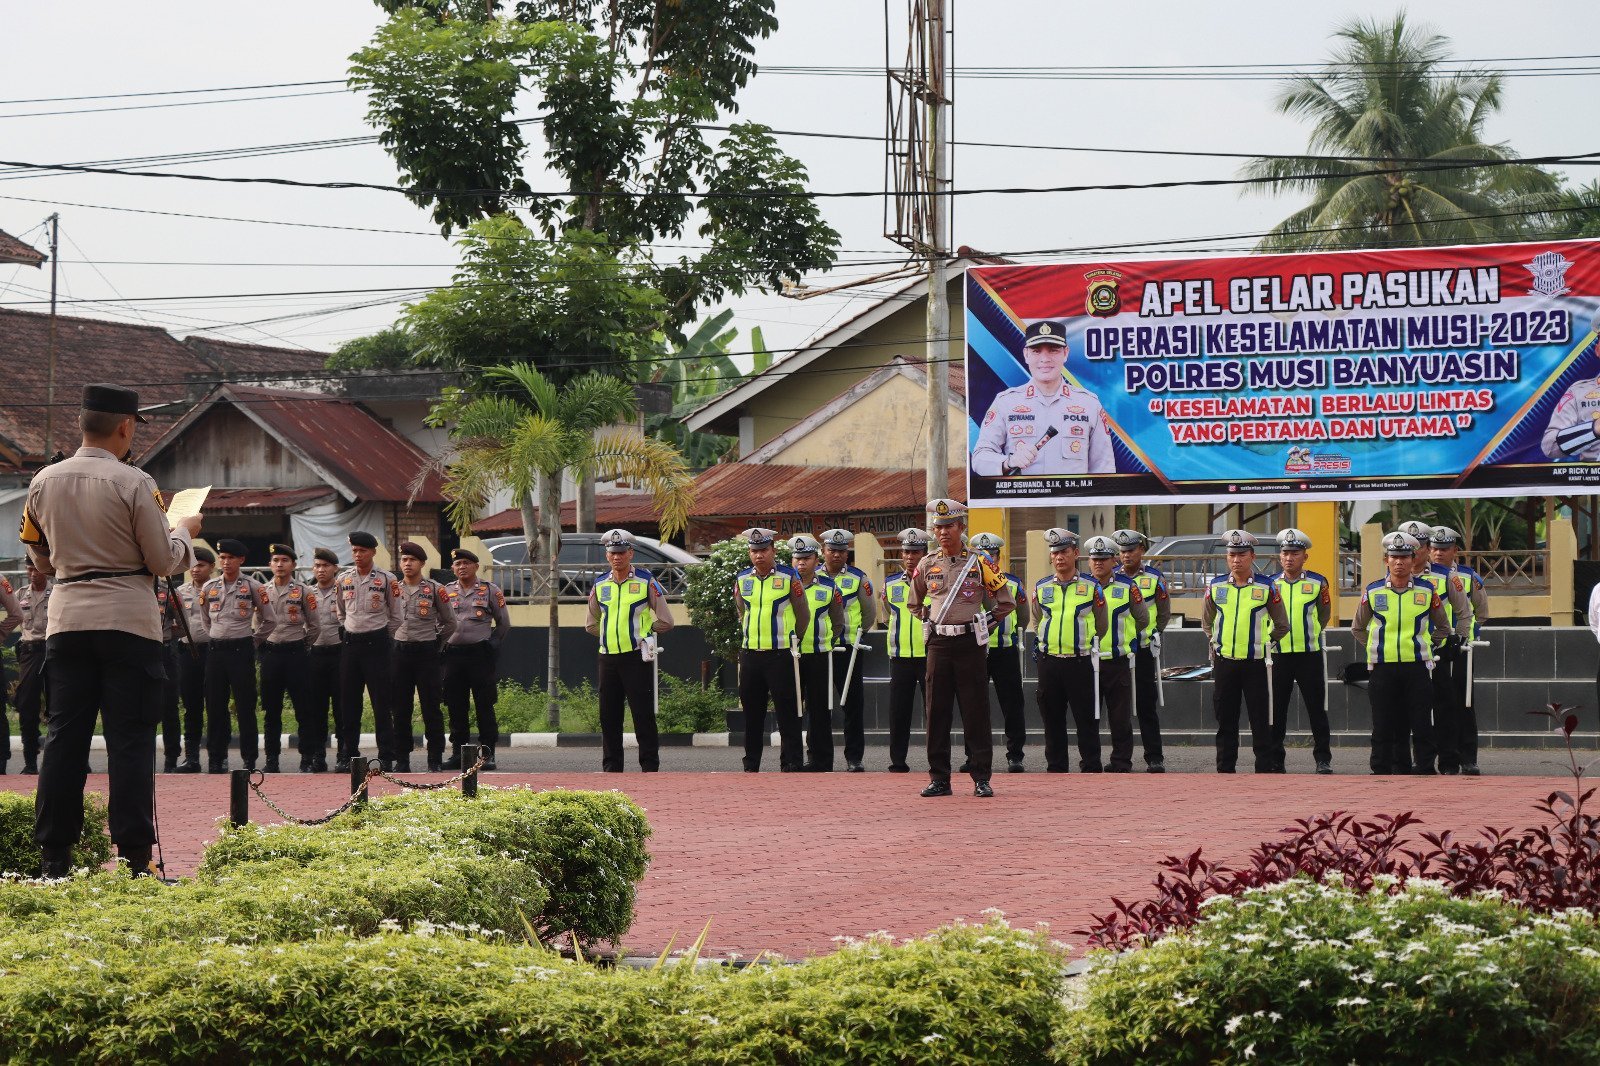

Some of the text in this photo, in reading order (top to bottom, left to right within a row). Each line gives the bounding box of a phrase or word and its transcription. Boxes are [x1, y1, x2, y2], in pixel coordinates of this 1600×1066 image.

[1140, 267, 1500, 316] APEL GELAR PASUKAN
[1085, 309, 1569, 358] OPERASI KESELAMATAN MUSI-2023
[1125, 350, 1518, 391] POLRES MUSI BANYUASIN
[1321, 393, 1414, 414] BERLALU
[1417, 390, 1492, 412] LINTAS
[1170, 420, 1224, 444] YANG
[1229, 420, 1327, 443] PERTAMA
[1330, 419, 1374, 438] DAN
[1313, 461, 1351, 470] PRESISI
[996, 481, 1011, 489] AKBP
[781, 519, 813, 535] AYAM
[824, 517, 855, 533] SATE
[859, 515, 917, 533] KAMBING
